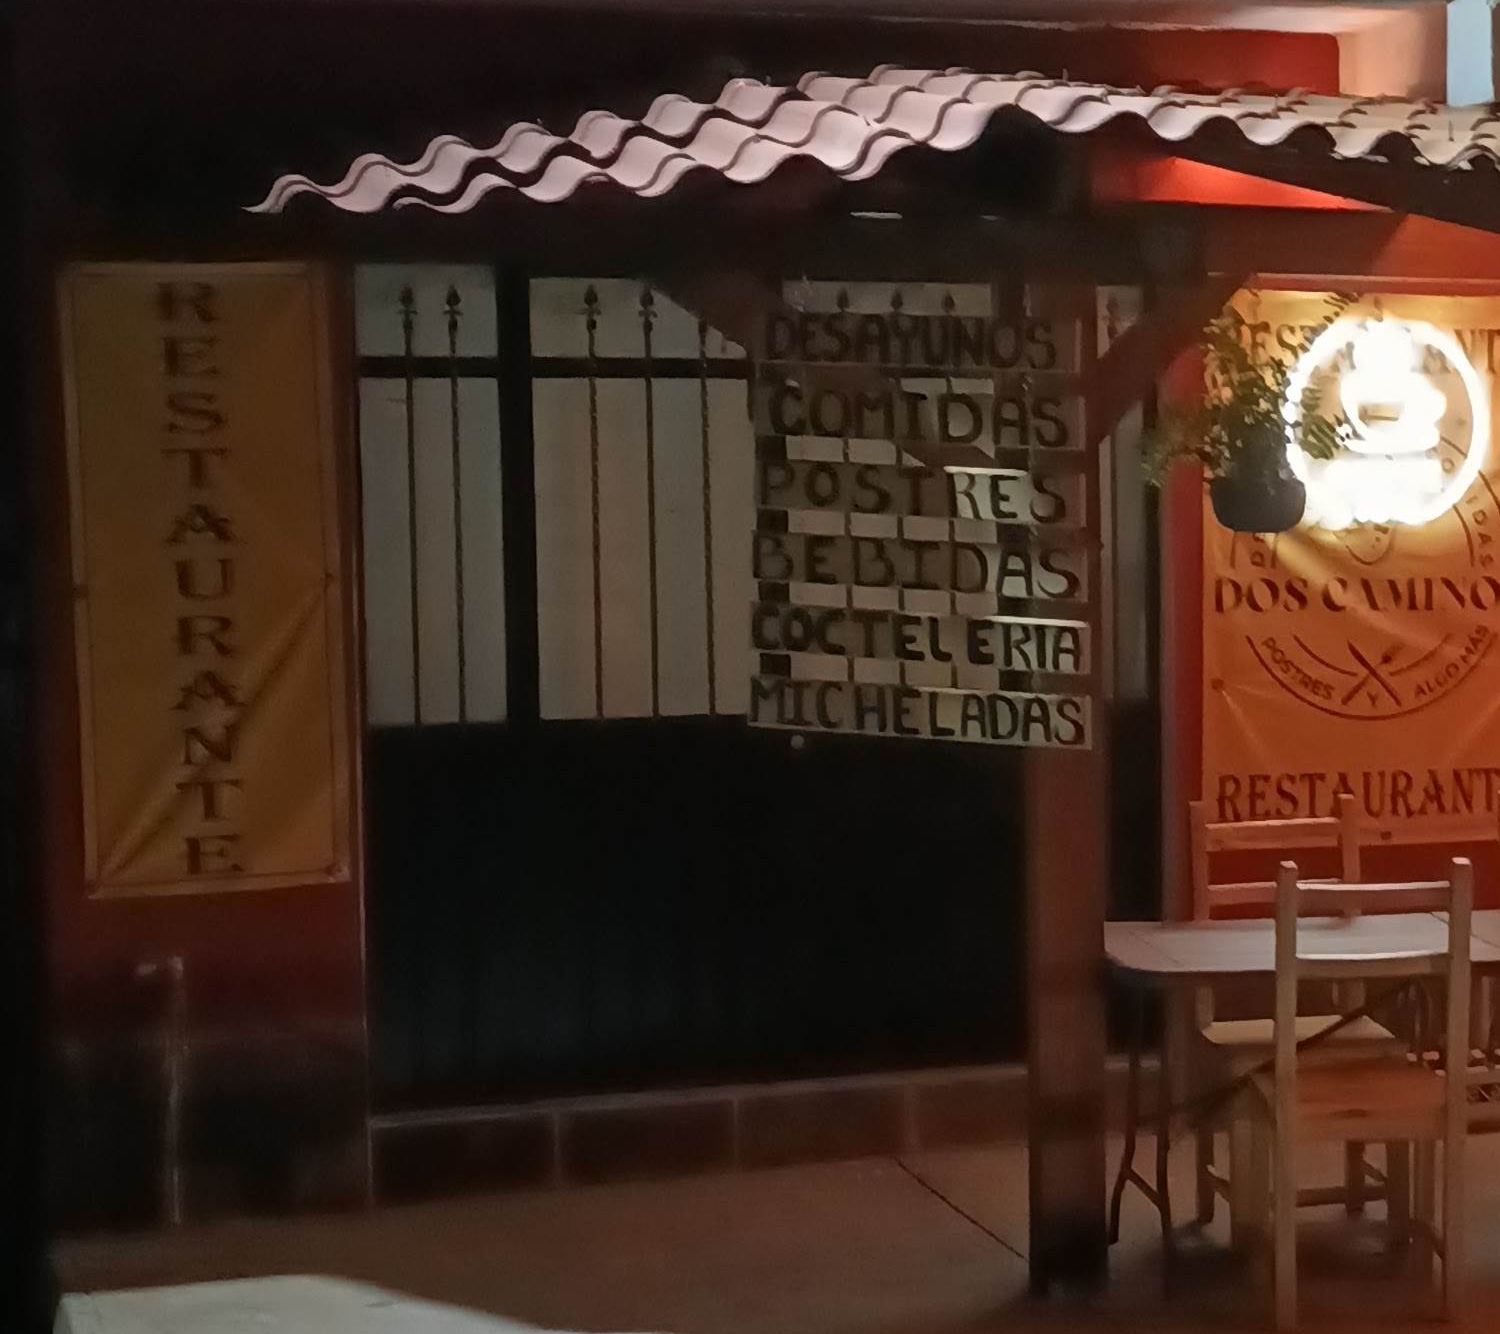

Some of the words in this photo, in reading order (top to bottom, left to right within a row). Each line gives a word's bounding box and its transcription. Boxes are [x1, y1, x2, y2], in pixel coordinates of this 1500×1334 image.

[766, 313, 1057, 369] DESAYUNOS
[769, 383, 1069, 448] COMIDAS
[759, 464, 1067, 523] POSTRES
[154, 280, 248, 876] RESTAURANTE
[752, 535, 1081, 598] BEBIDAS
[1215, 576, 1308, 613] DOS
[752, 608, 1081, 673] COCTELERIA
[1261, 636, 1335, 701] POSTRES
[1414, 661, 1459, 698] ALGO
[750, 676, 1085, 745] MICHELADAS
